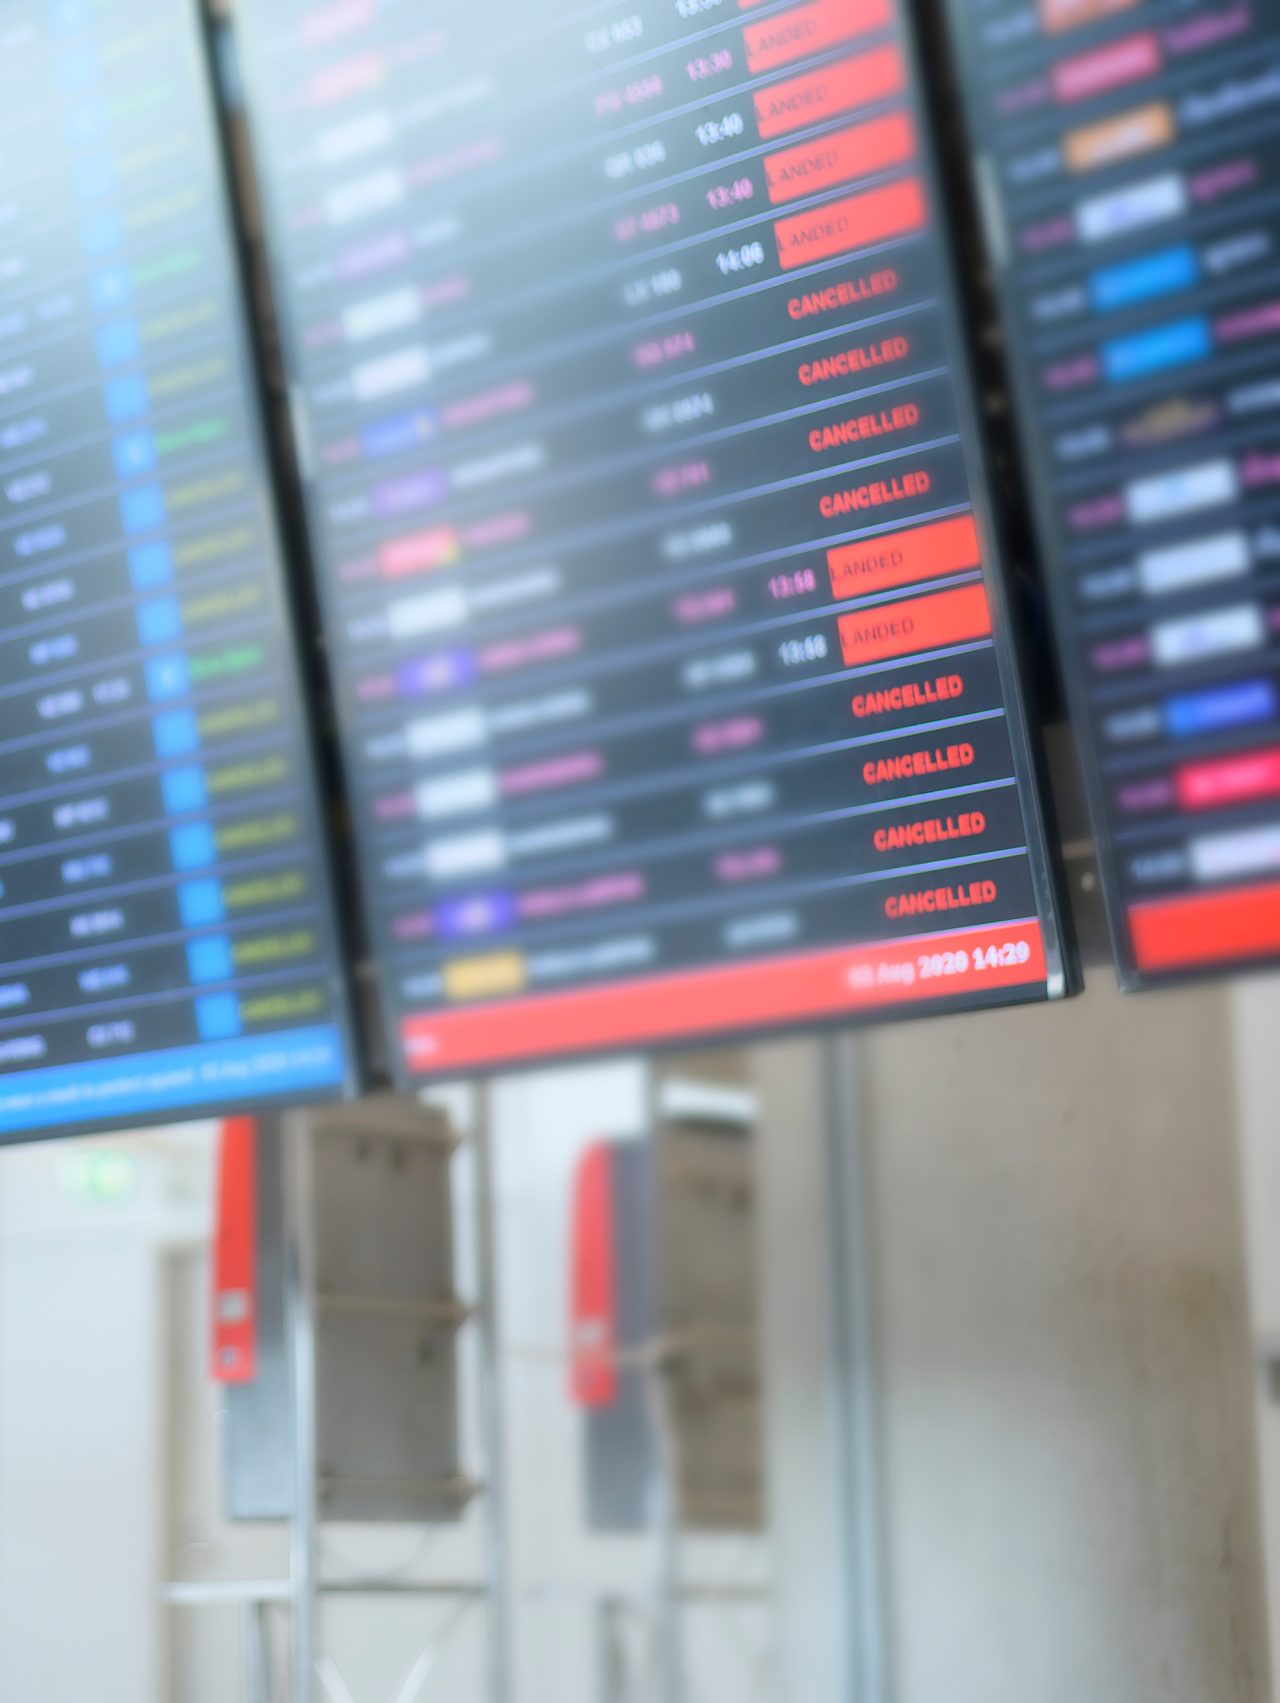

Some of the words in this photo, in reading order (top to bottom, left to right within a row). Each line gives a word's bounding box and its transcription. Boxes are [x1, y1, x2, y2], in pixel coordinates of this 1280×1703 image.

[787, 267, 898, 321] CANCELLED
[797, 334, 910, 387] CANCELLED
[808, 402, 920, 453] CANCELLED
[819, 469, 931, 518] CANCELLED
[829, 550, 904, 582] LANDED
[840, 618, 914, 650] LANDED
[851, 673, 964, 719] CANCELLED
[862, 742, 975, 785] CANCELLED
[873, 811, 986, 852] CANCELLED
[884, 879, 997, 919] CANCELLED
[918, 949, 969, 979] 2020
[971, 940, 1030, 971] 14:29
